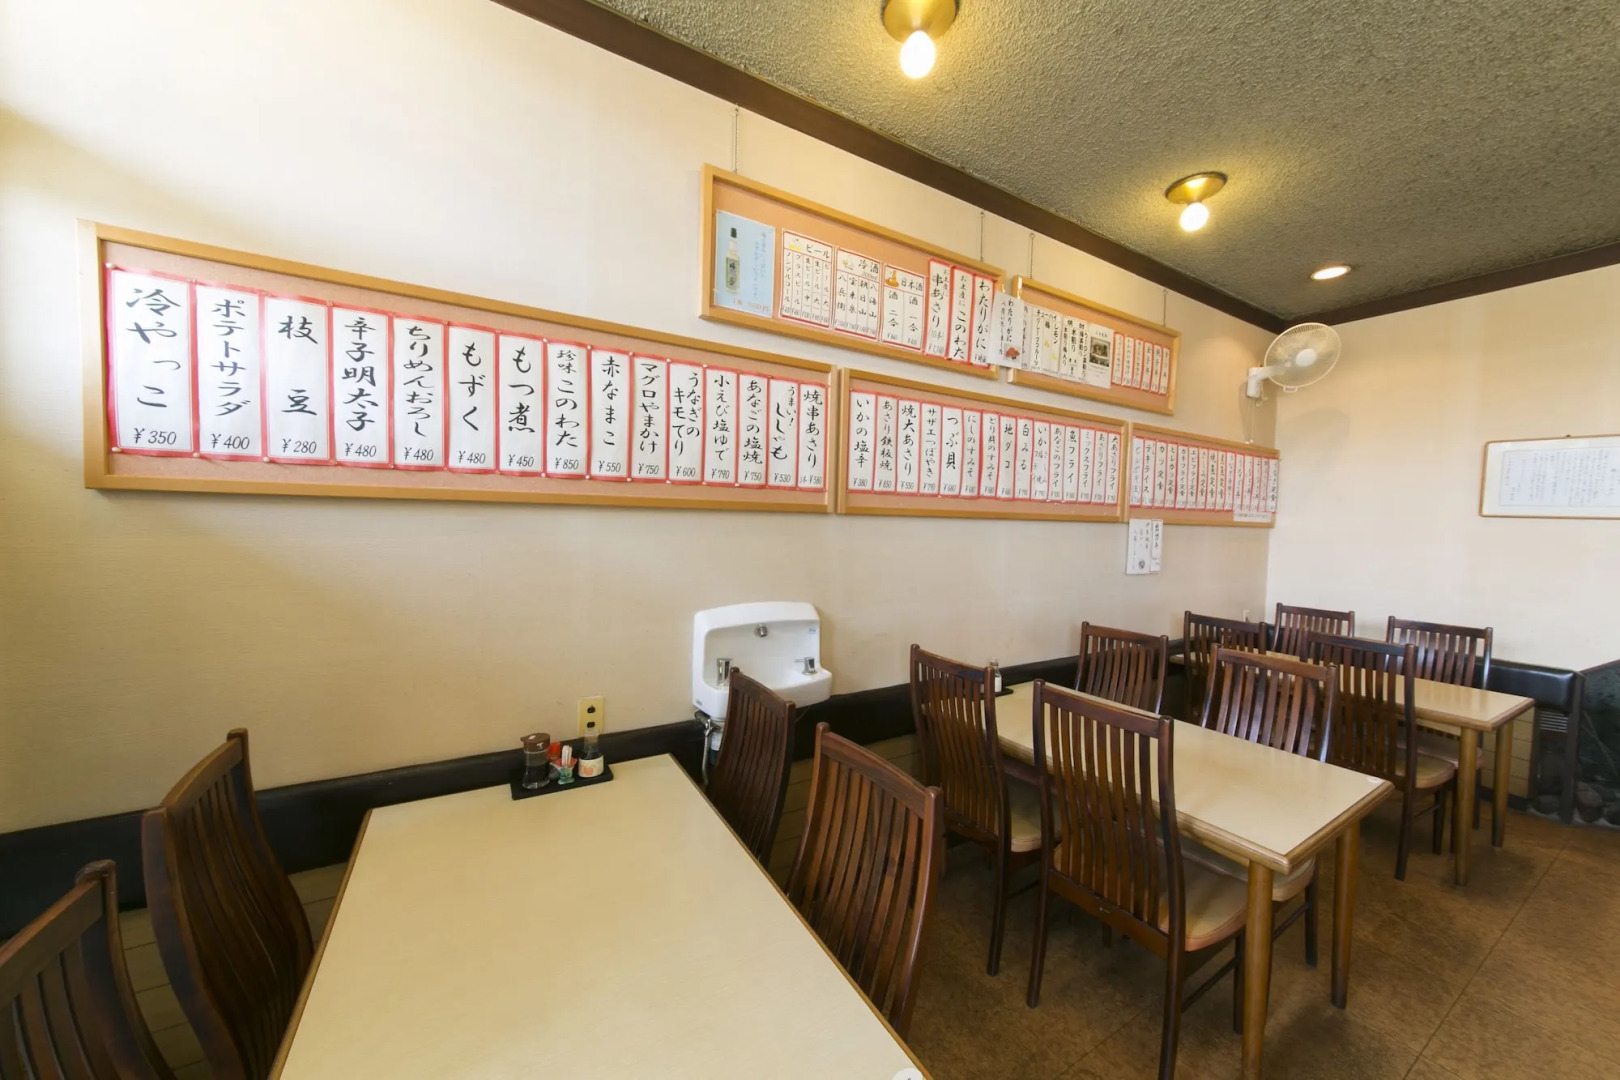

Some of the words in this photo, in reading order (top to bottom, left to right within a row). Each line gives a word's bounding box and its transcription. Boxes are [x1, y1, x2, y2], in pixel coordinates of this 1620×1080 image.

[806, 244, 829, 259] ビール
[858, 259, 879, 274] 冷酒
[901, 278, 923, 292] 日本酒
[931, 273, 944, 328] 串あさり
[953, 310, 967, 359] このわた
[975, 280, 990, 349] わたりがに
[126, 287, 181, 408] 冷やっこ
[211, 299, 251, 417] ポテトサラダ
[278, 316, 318, 415] 枝豆
[341, 317, 379, 432] 辛子明太子
[403, 325, 435, 438] ちりめんおろし
[457, 341, 486, 432] もずく
[508, 346, 536, 434] もつ煮
[602, 356, 621, 446] 赤なまこ
[639, 362, 660, 455] マグロやまかけ
[686, 372, 702, 438] うなぎの
[133, 428, 177, 446] ¥350
[211, 434, 250, 450] ¥400
[281, 438, 317, 454] ¥280
[672, 387, 687, 457] キモてり
[712, 375, 730, 461] 小えび塩ゆで
[742, 380, 763, 465] あなごの塩焼
[770, 402, 788, 461] ししゃも
[803, 389, 823, 468] 焼串あさり
[854, 399, 870, 468] いかの塩辛
[880, 401, 893, 472] あさり鉄板焼
[902, 404, 917, 476] 焼大あさり
[925, 408, 937, 478] サザエつぼやき
[946, 417, 959, 470] つぶ貝
[1038, 427, 1047, 447] いか
[344, 442, 377, 458] ¥480
[403, 447, 434, 461] ¥480
[458, 450, 486, 464] ¥480
[508, 454, 535, 468] ¥450
[555, 457, 579, 471] ¥850
[598, 460, 622, 473] ¥550
[638, 463, 660, 476] ¥750
[676, 465, 696, 478] ¥600
[744, 470, 762, 482] ¥750
[987, 417, 996, 480] とり貝のすみそ
[1053, 427, 1062, 488] あなごのフライ
[1067, 430, 1077, 484] 魚フライ
[1083, 431, 1091, 488] ミックスフライ
[1109, 435, 1118, 490] 大あさりフライ
[774, 472, 791, 484] ¥530
